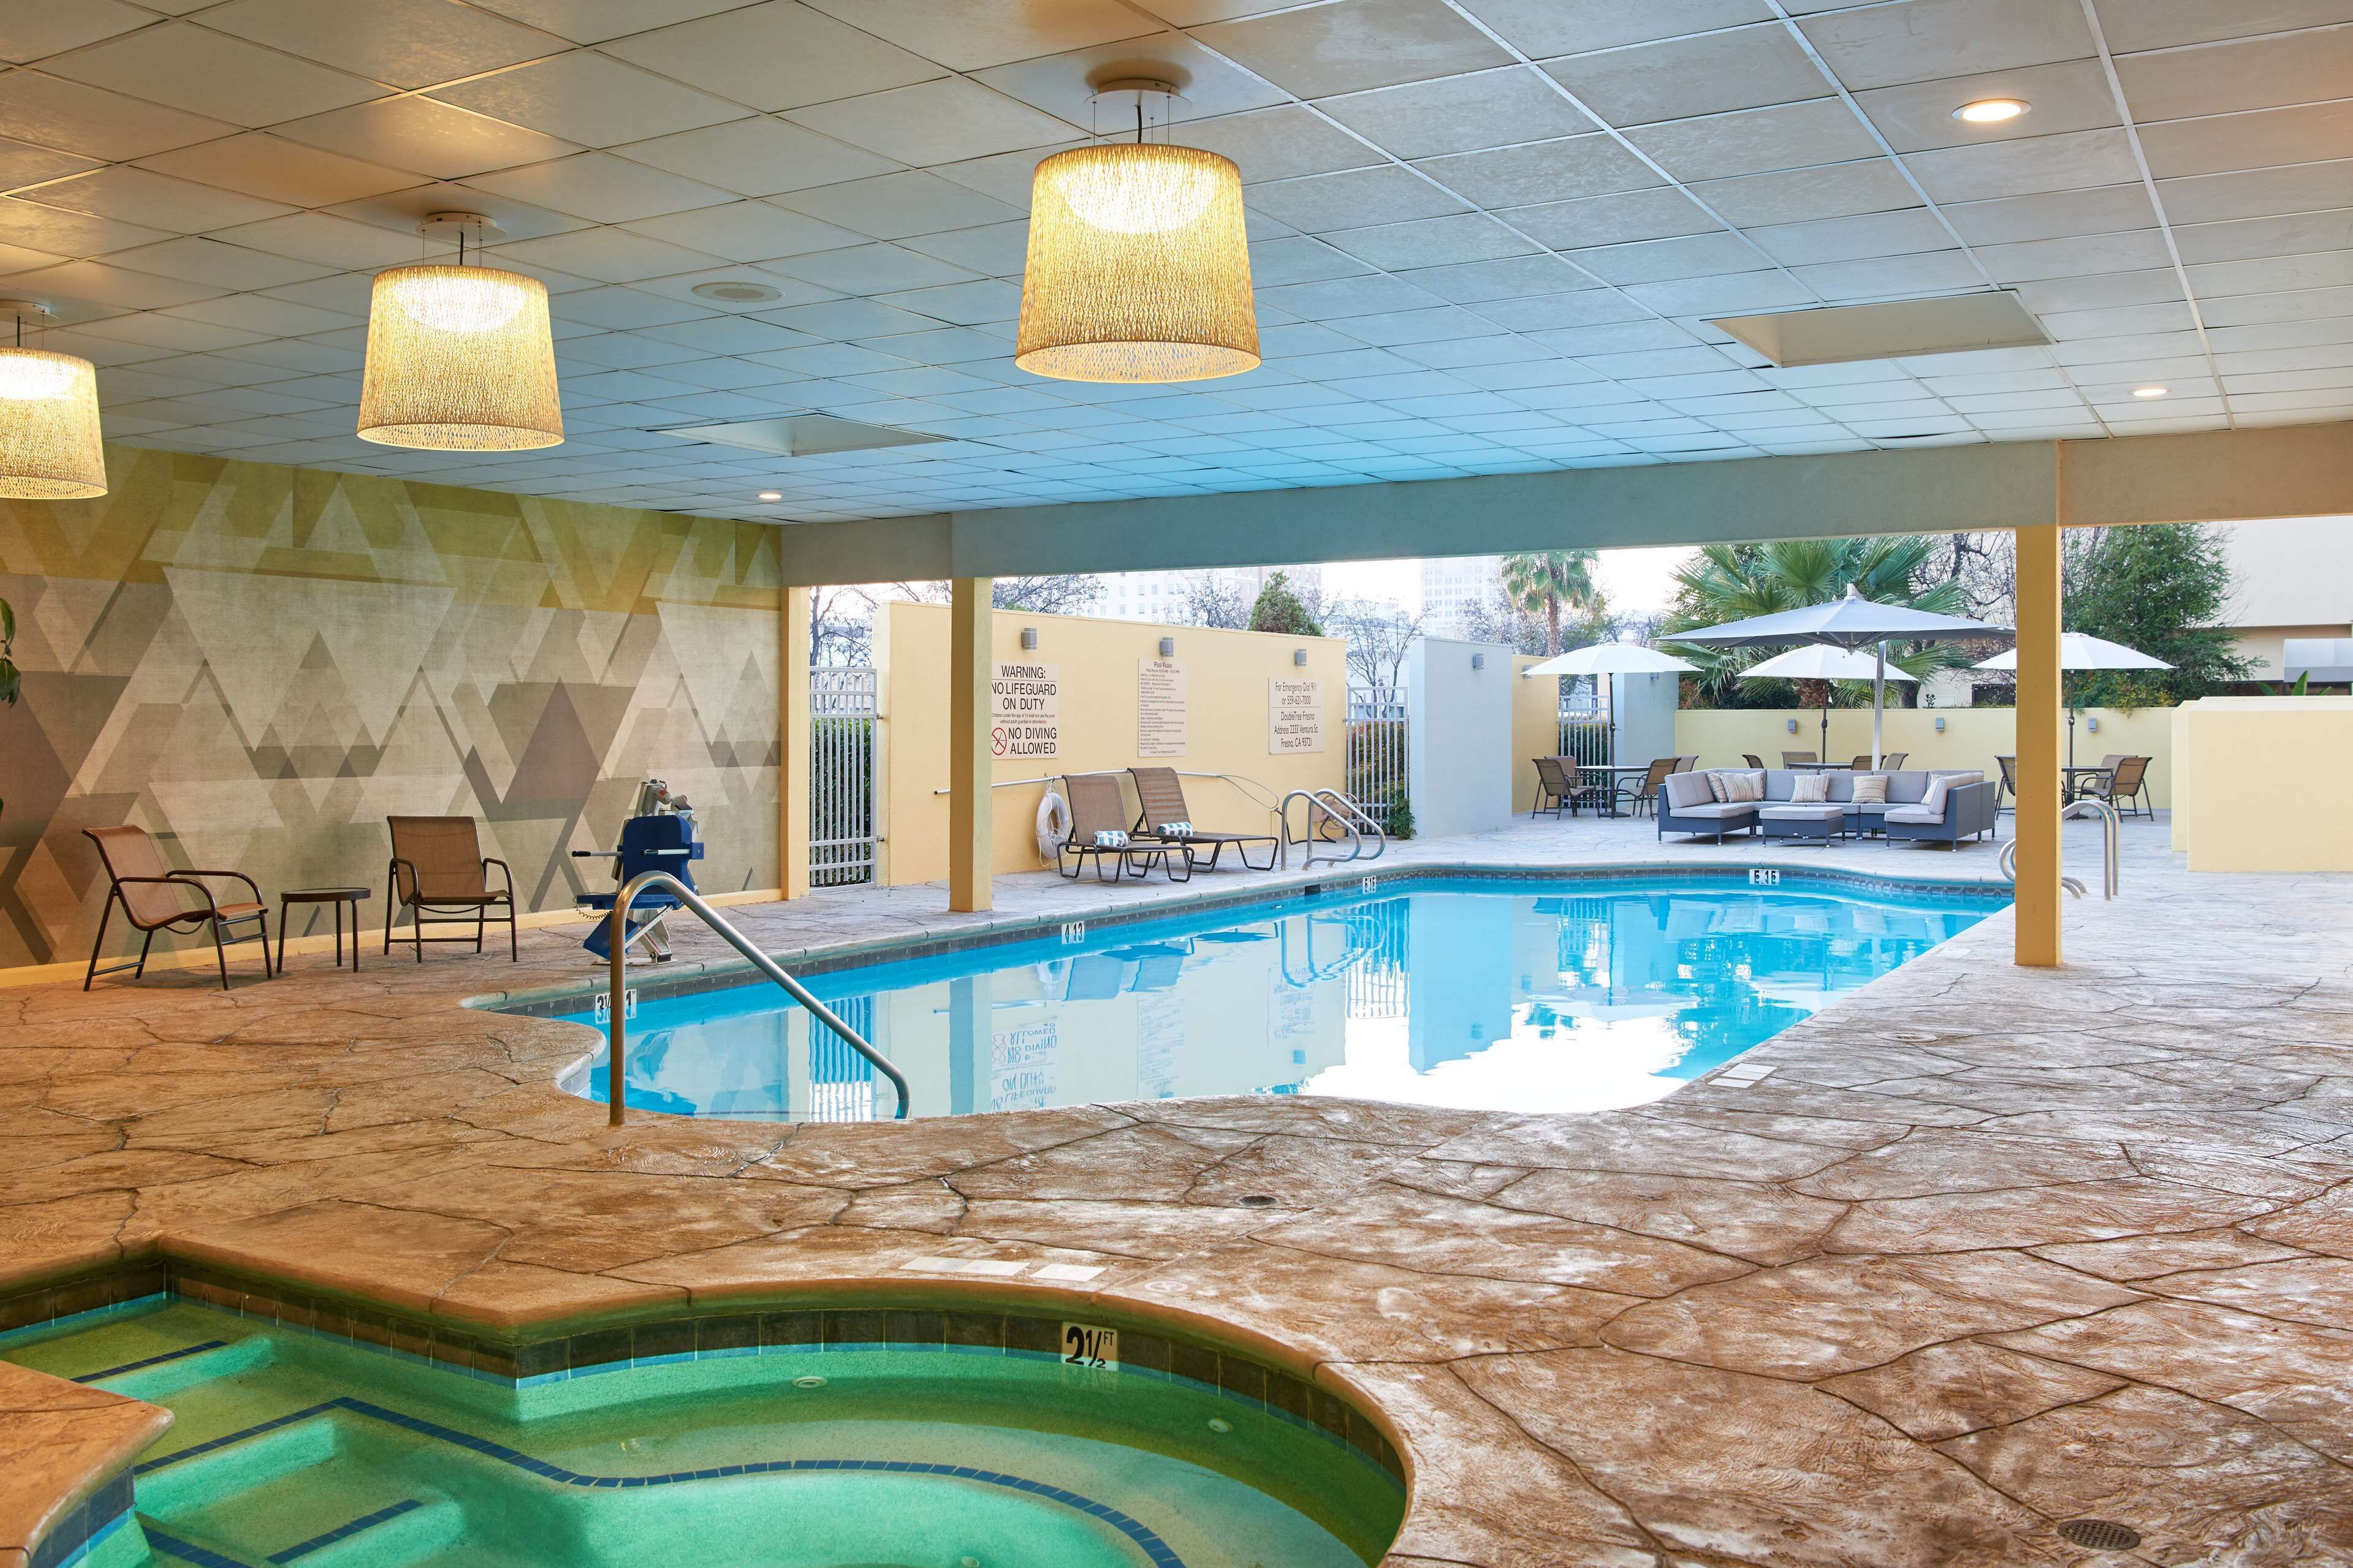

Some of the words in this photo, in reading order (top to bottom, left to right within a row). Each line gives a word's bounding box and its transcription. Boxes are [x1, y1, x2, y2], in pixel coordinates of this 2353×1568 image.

[1001, 665, 1046, 679] WARNING:
[992, 682, 1004, 694] NO
[1006, 683, 1056, 695] LIFEGUARD
[1283, 681, 1302, 694] Emergency
[1003, 697, 1016, 710] ON
[1020, 698, 1045, 710] DUTY
[1280, 711, 1302, 721] DoubleTree
[1302, 711, 1314, 720] Fresno
[1008, 727, 1022, 739] NO
[1025, 727, 1057, 740] DIVING
[1274, 725, 1289, 734] Address
[1290, 724, 1299, 734] 2233
[1299, 724, 1313, 733] Ventura
[1010, 742, 1056, 754] ALLOWED
[1280, 738, 1294, 748] Fresno,
[1294, 737, 1301, 747] CA
[1302, 737, 1312, 746] 93721
[1104, 1331, 1114, 1346] FT
